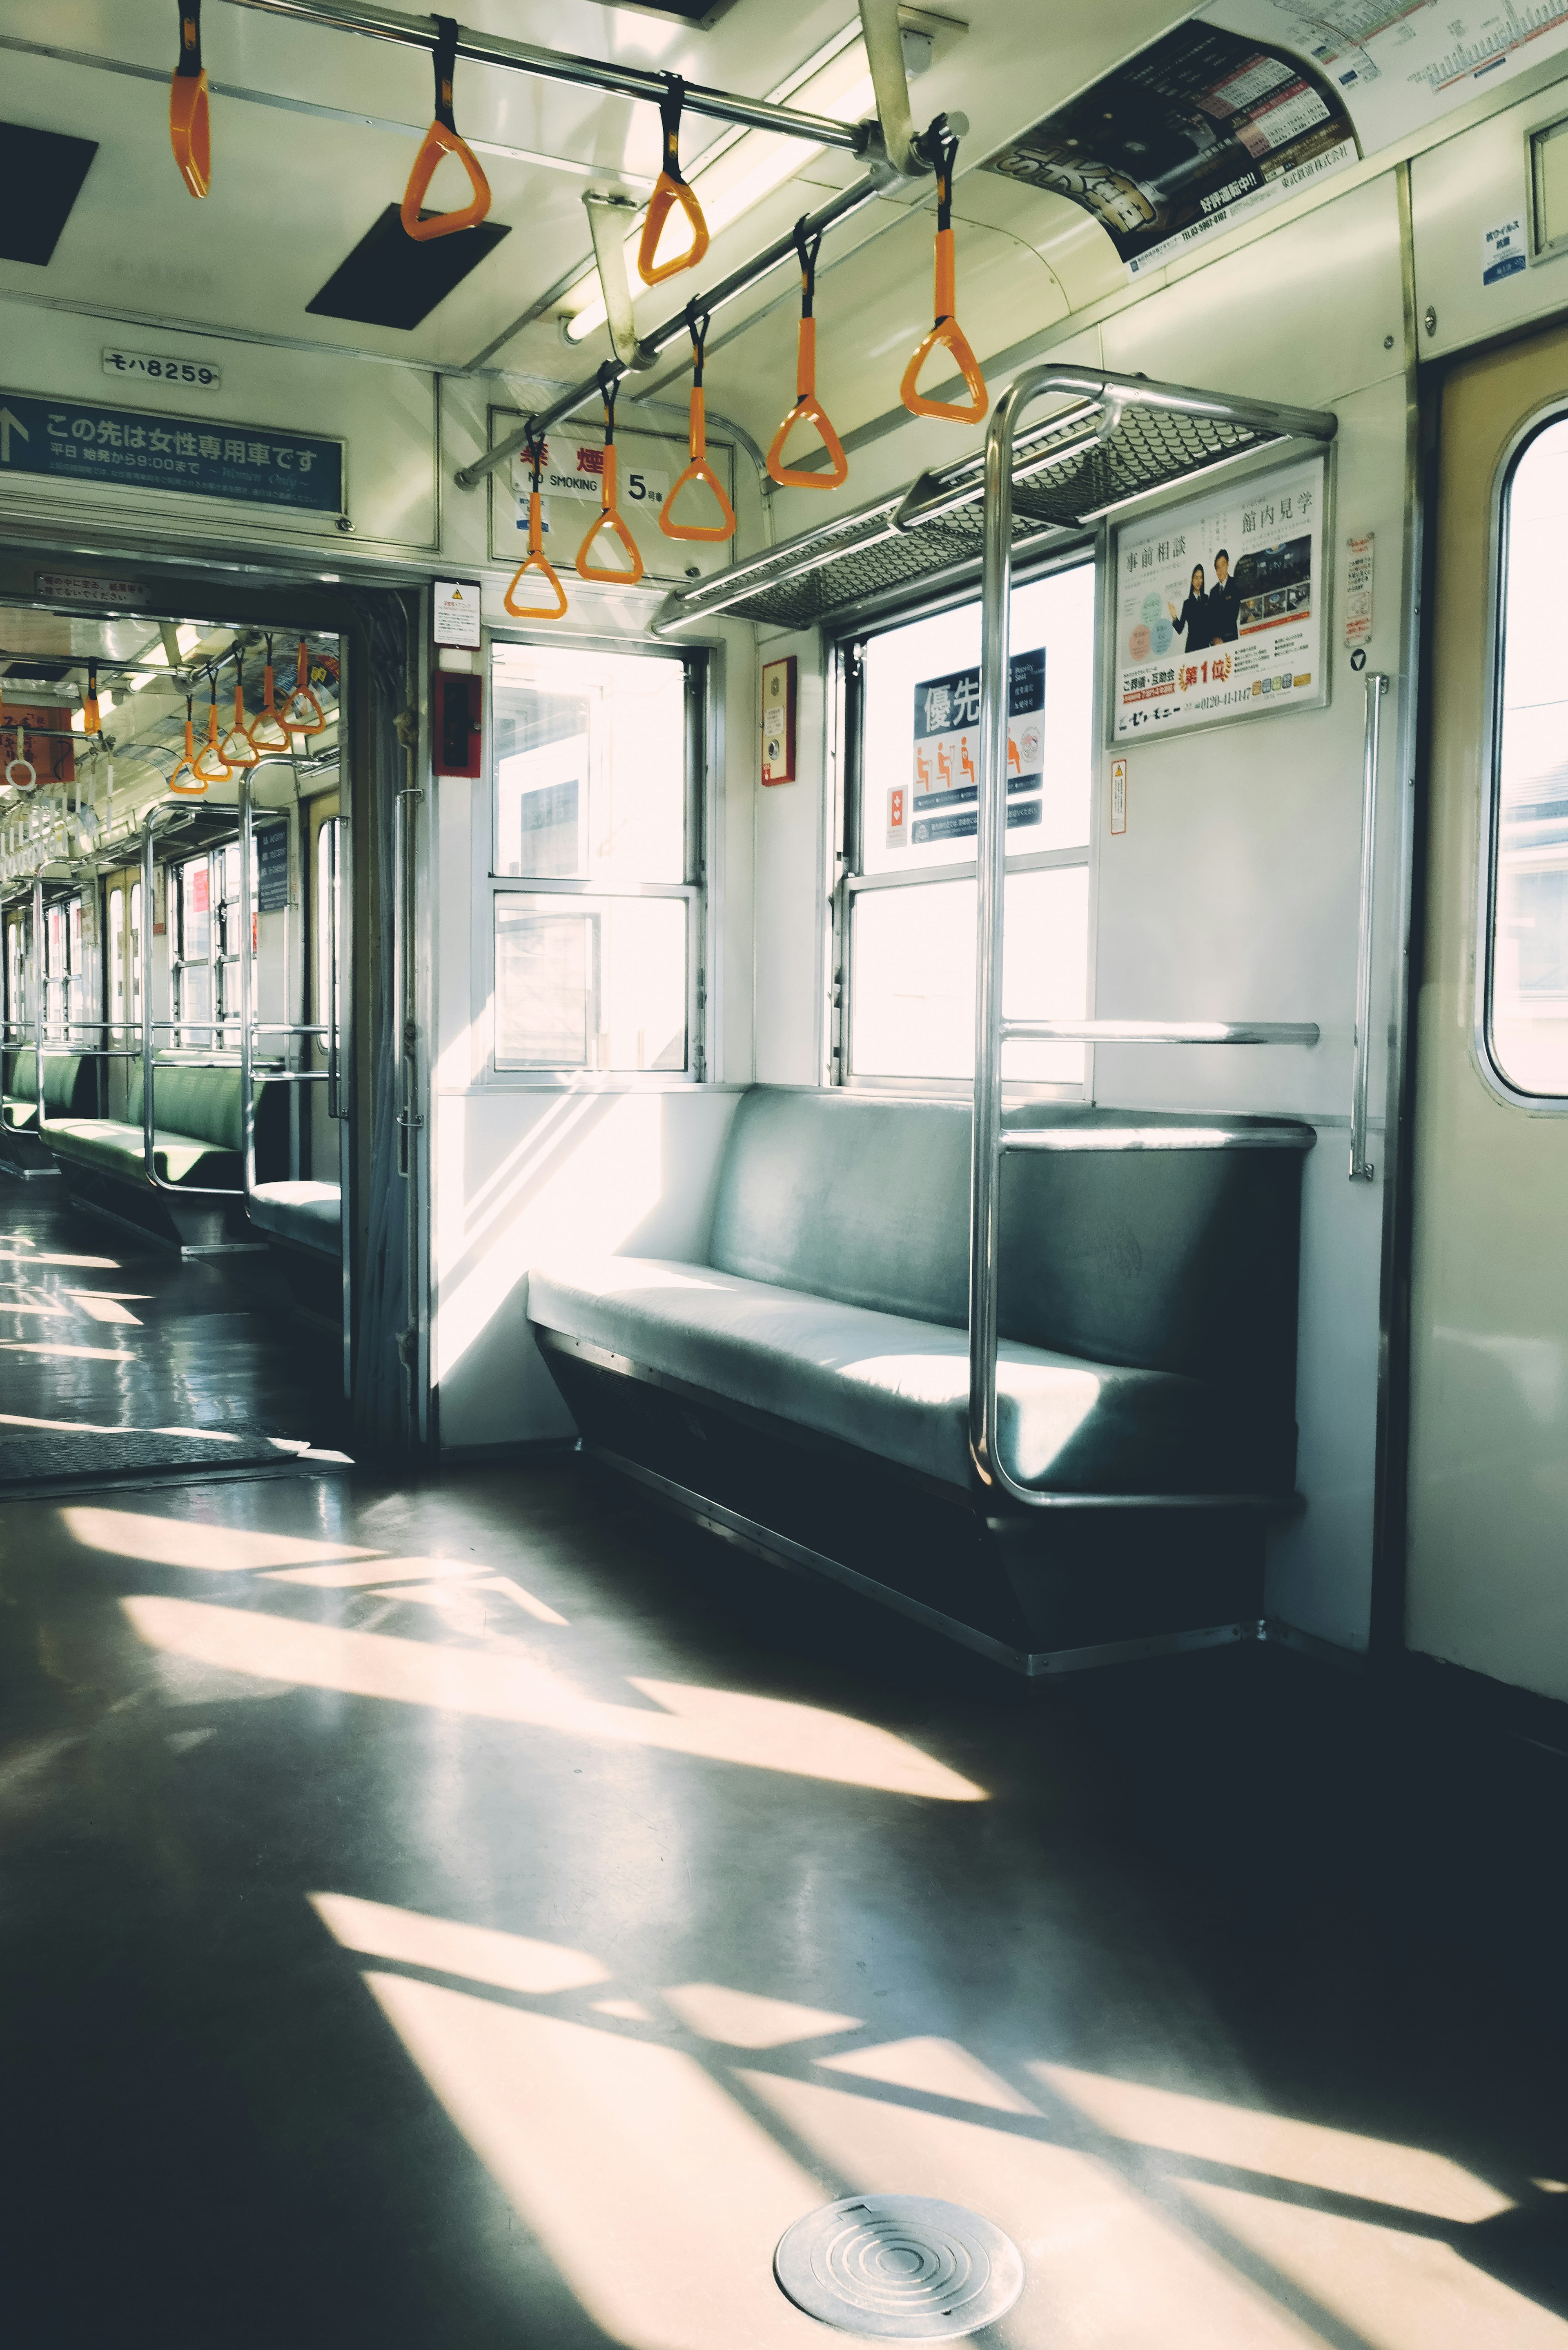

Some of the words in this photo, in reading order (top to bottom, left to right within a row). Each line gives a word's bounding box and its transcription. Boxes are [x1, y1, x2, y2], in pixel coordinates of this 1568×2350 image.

[107, 354, 212, 384] モハ8259
[47, 414, 317, 472] この先は女性専用車です
[50, 442, 77, 458] 平日
[83, 447, 200, 474] 始発から9:00まで
[550, 474, 598, 491] SMOKING
[1242, 491, 1312, 534] 館内見学
[1126, 535, 1186, 572] 事前相談
[1186, 659, 1226, 686] 第1位
[924, 676, 981, 733] 優先
